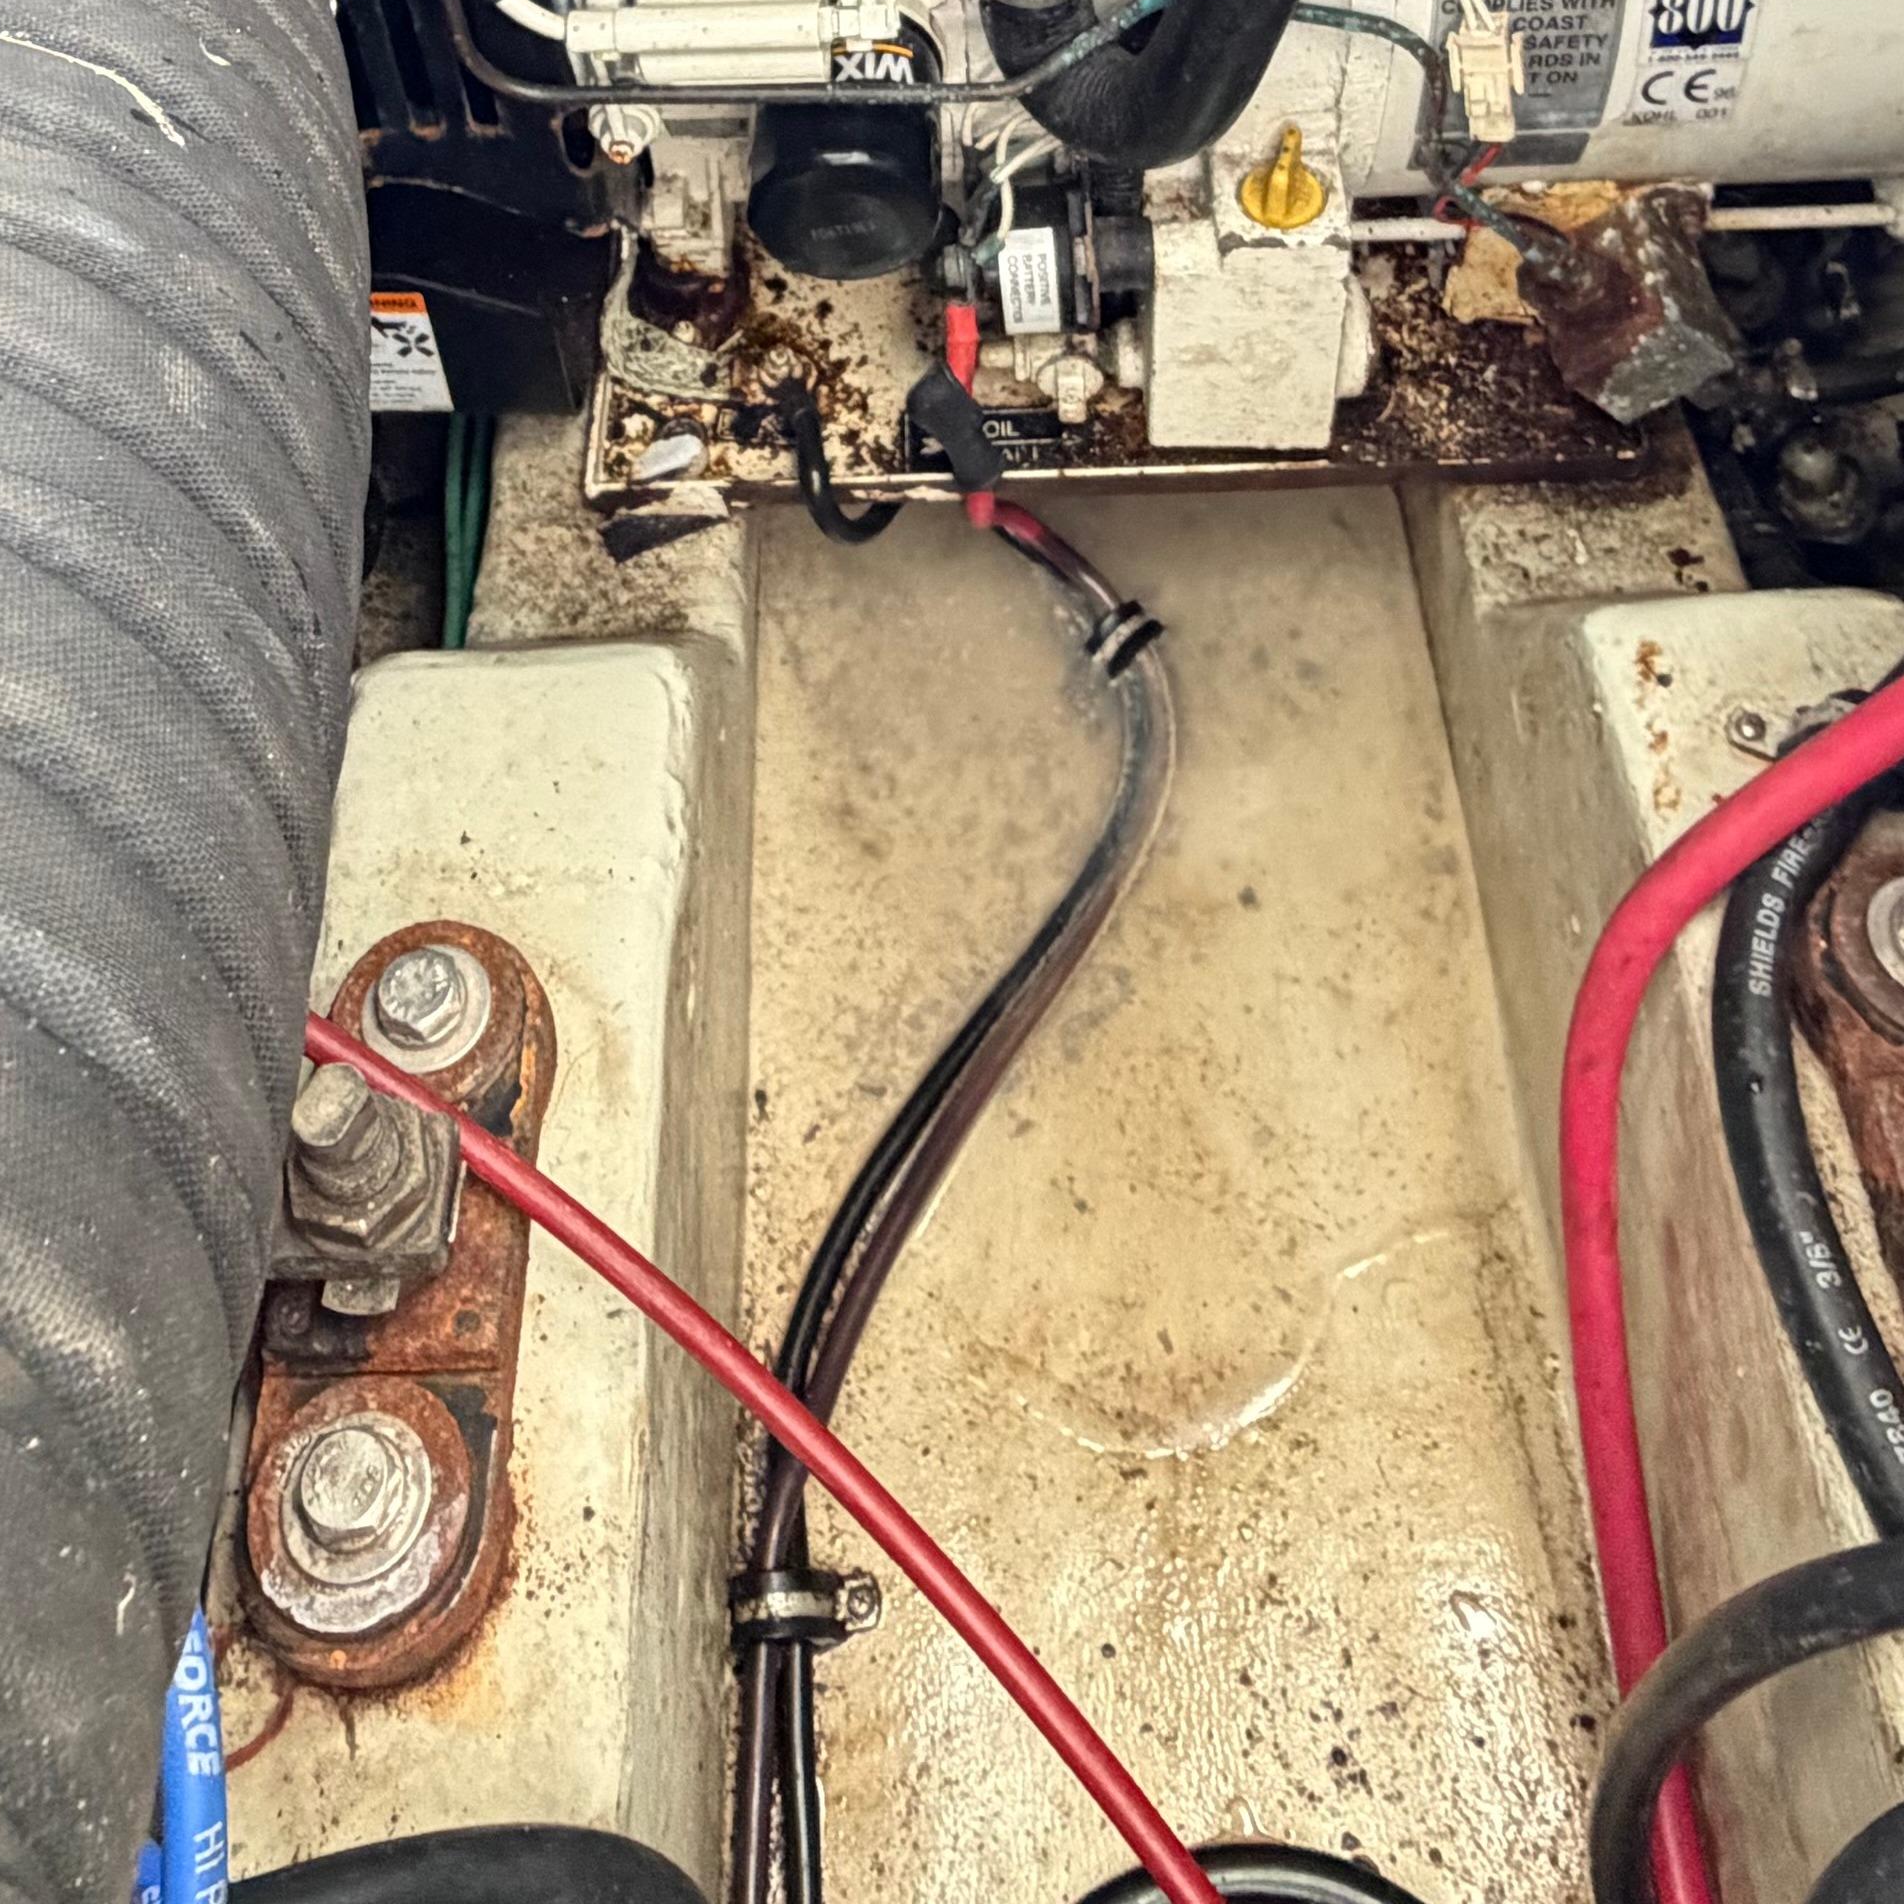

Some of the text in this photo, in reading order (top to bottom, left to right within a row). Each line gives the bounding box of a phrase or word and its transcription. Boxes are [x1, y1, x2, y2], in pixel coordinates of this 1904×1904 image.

[1512, 15, 1589, 32] COAST
[1523, 33, 1609, 50] SAFETY
[1579, 52, 1602, 66] IN
[832, 51, 915, 86] WIX
[1546, 70, 1579, 84] ON
[1641, 68, 1717, 106] CE
[1021, 254, 1037, 306] BATTERY
[1036, 252, 1052, 307] POSITIVE
[981, 419, 1021, 439] OIL
[1748, 892, 1786, 997] SHIELDS
[193, 1820, 226, 1875] HI
